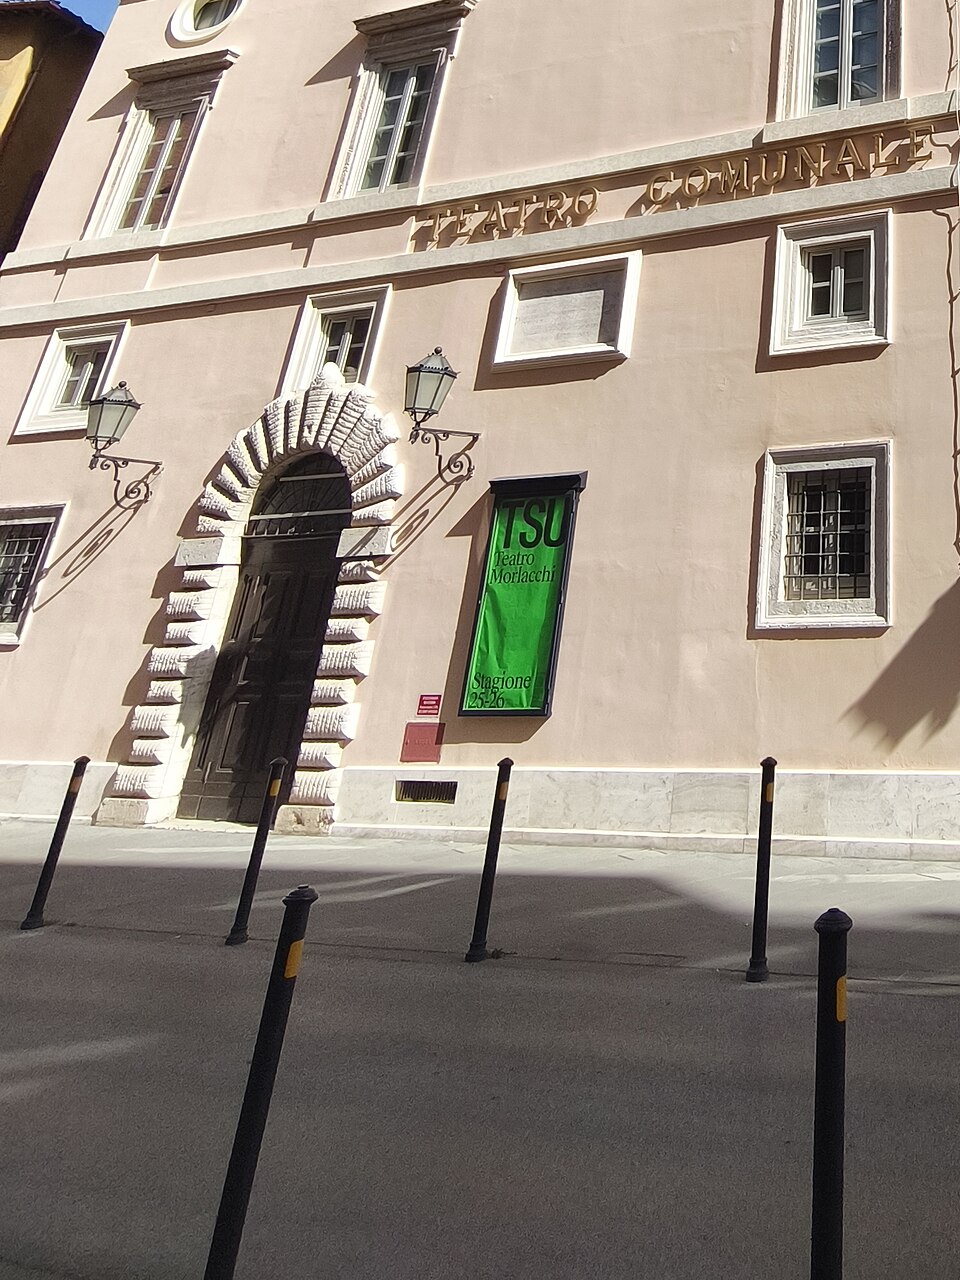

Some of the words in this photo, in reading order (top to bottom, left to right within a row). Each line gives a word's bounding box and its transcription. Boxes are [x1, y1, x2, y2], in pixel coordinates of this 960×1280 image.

[424, 186, 601, 241] TEATRO
[647, 124, 936, 204] COMUNALE
[501, 495, 573, 550] TSU
[494, 551, 535, 568] Teatro
[489, 565, 556, 584] Morlacchi
[472, 671, 532, 693] Stagione
[468, 691, 505, 709] 25-26
